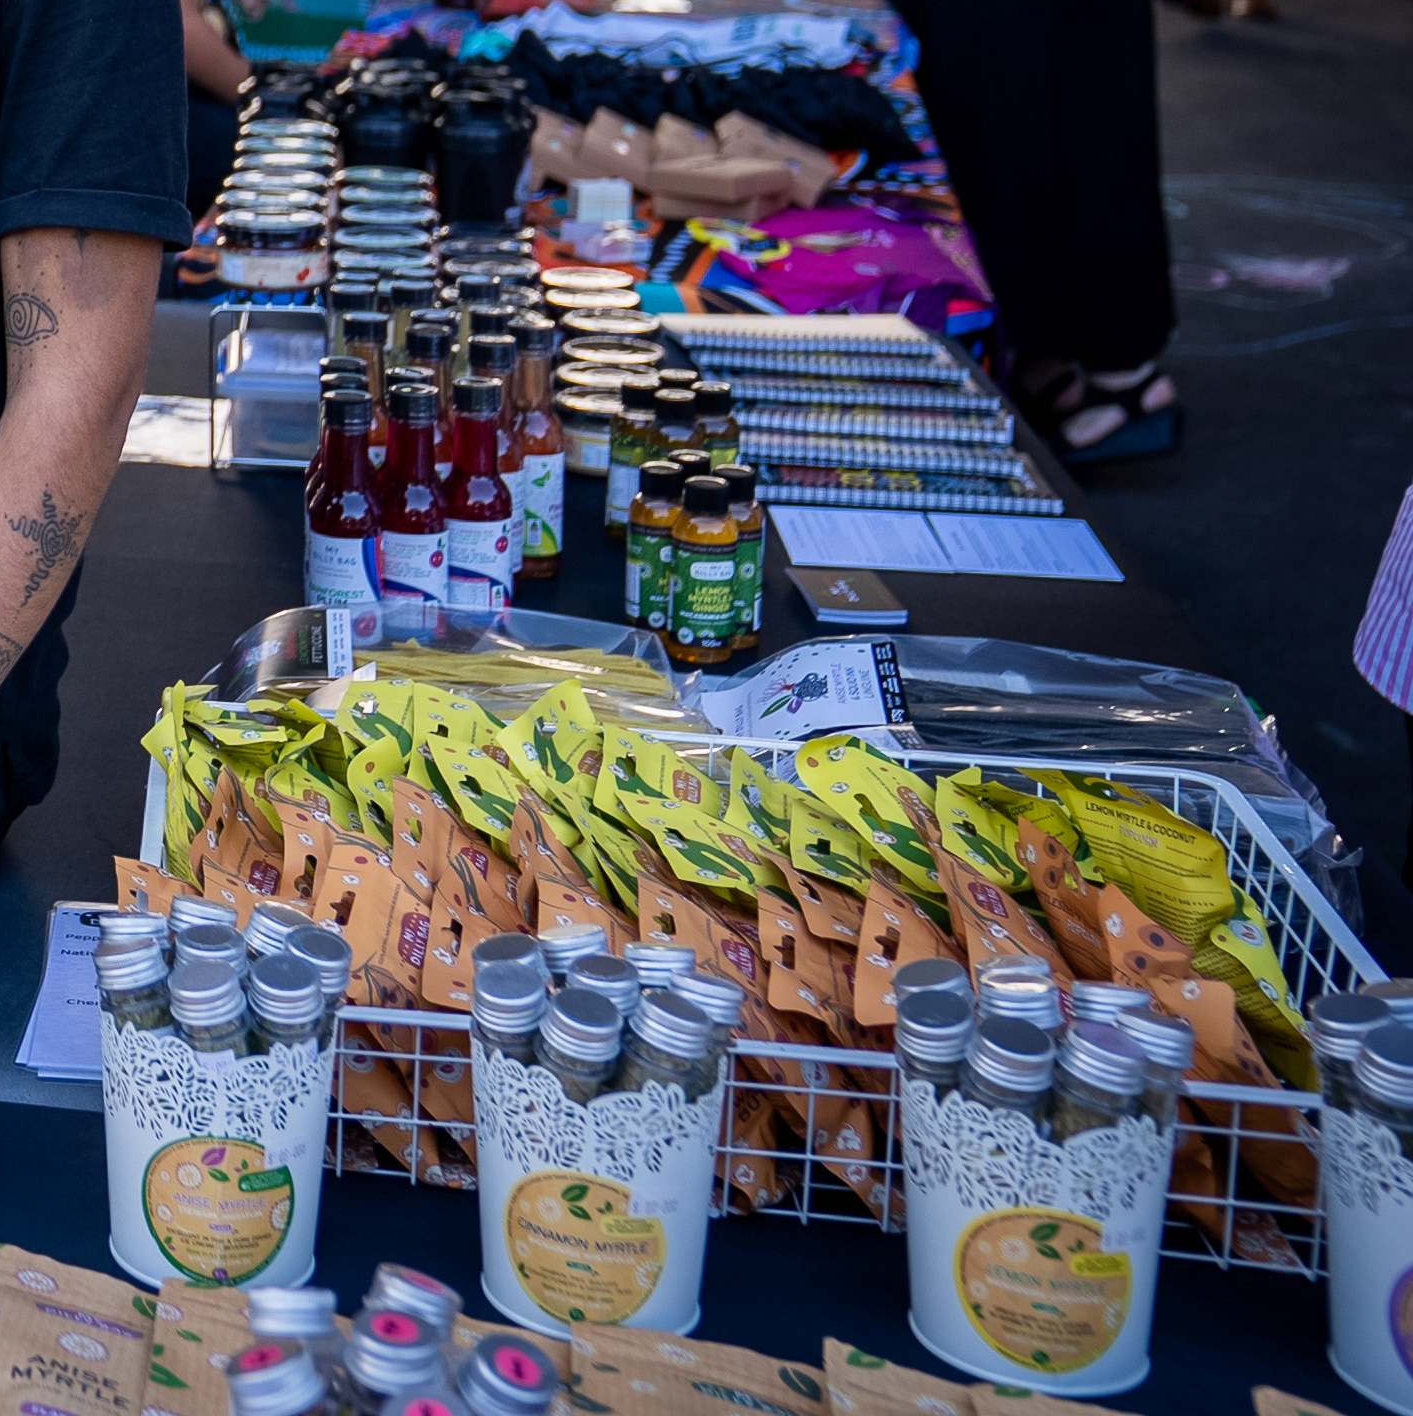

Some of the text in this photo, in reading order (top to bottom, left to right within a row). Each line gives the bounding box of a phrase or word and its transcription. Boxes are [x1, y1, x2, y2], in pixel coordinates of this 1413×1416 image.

[1085, 801, 1115, 818] LEMON
[1153, 823, 1197, 845] COCONUT
[517, 1216, 589, 1250] CINNAMON
[595, 1241, 649, 1254] MYRTLE
[11, 1365, 130, 1409] MYRTLE
[29, 1354, 118, 1392] ANISE
